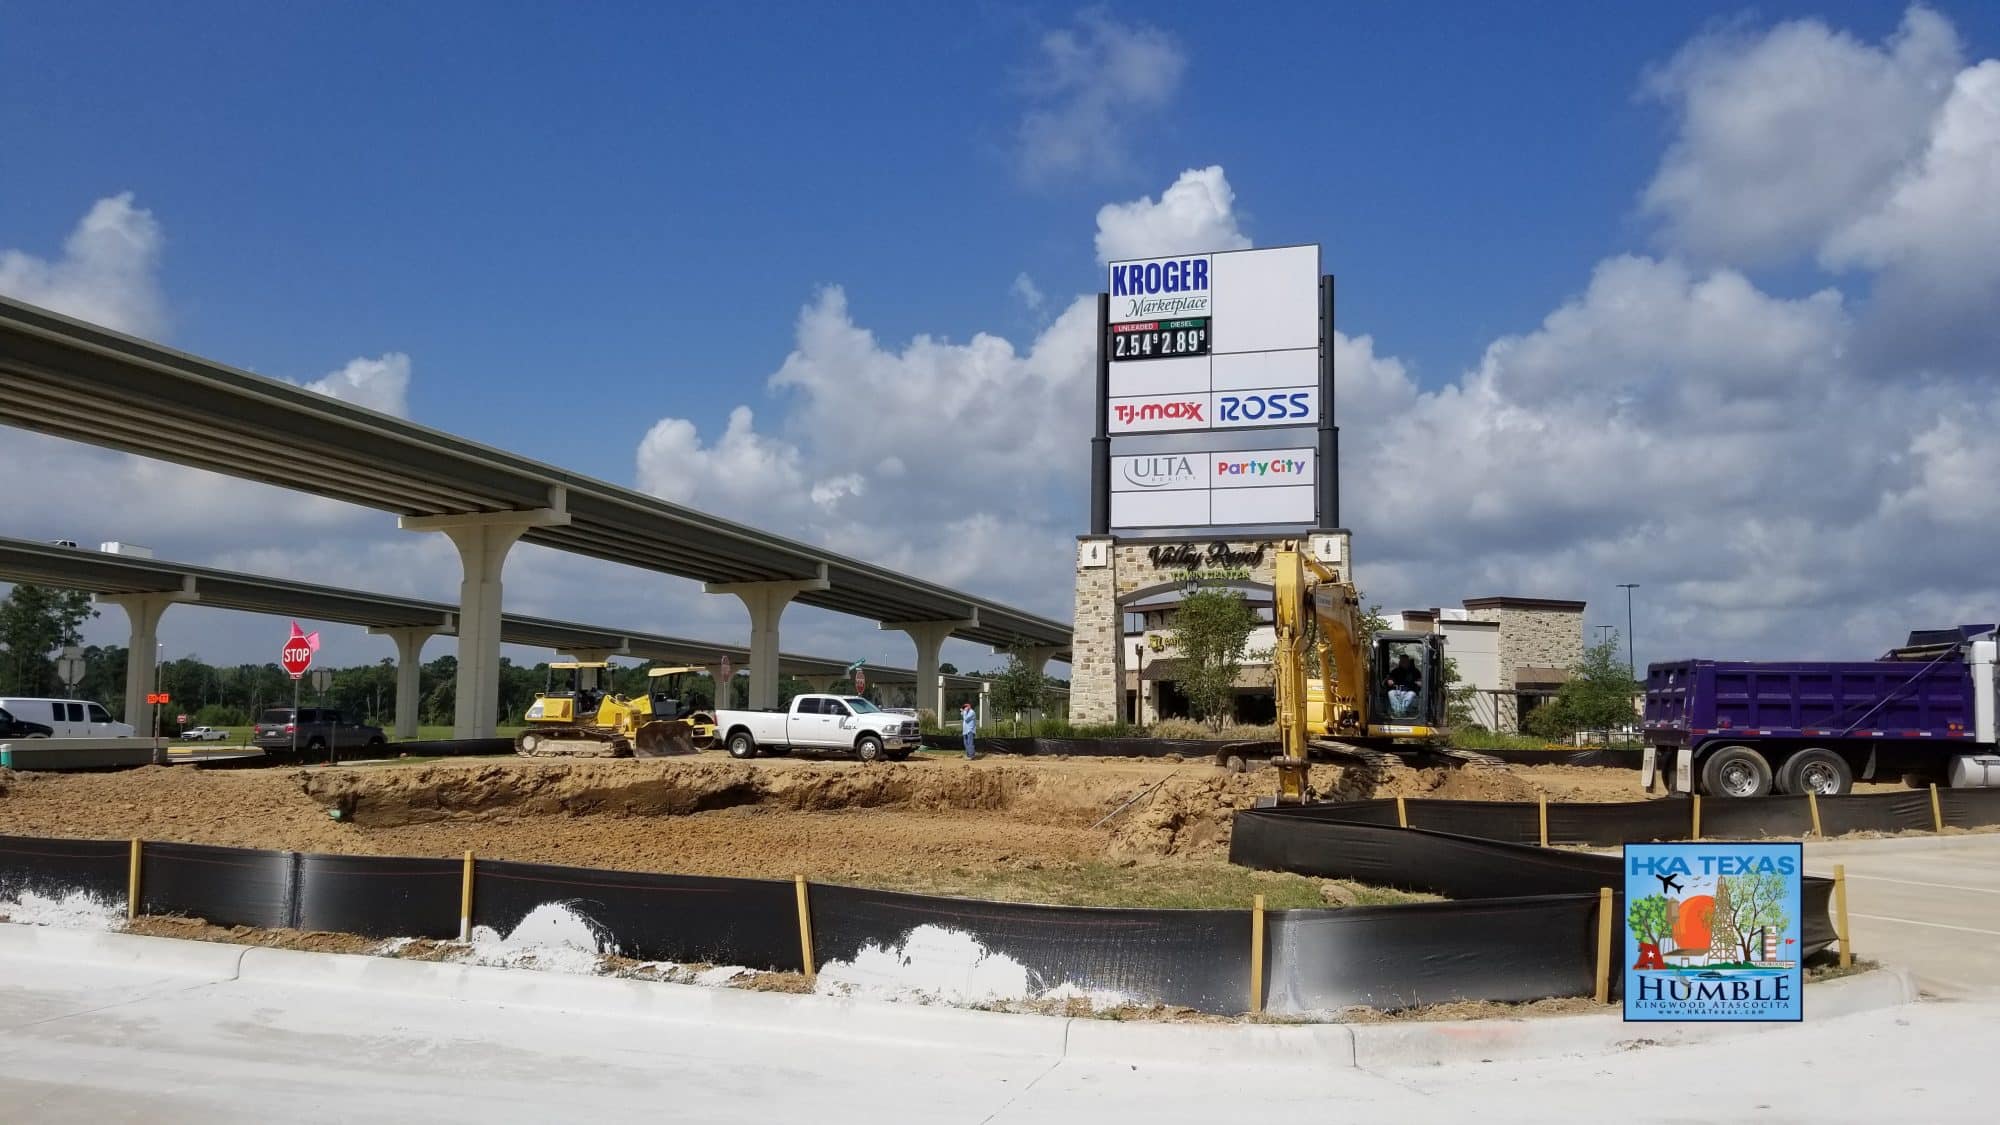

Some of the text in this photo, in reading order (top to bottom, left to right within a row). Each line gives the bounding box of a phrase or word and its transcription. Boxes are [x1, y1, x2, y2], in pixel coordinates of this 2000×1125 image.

[1112, 259, 1208, 297] KROGER
[1125, 296, 1208, 318] Marketplace
[1118, 323, 1154, 332] UNLEADED
[1170, 320, 1193, 328] DIESEL
[1220, 393, 1309, 421] ROSS
[1134, 456, 1193, 477] ULTA
[1218, 459, 1305, 476] Party City
[284, 648, 310, 663] STOP
